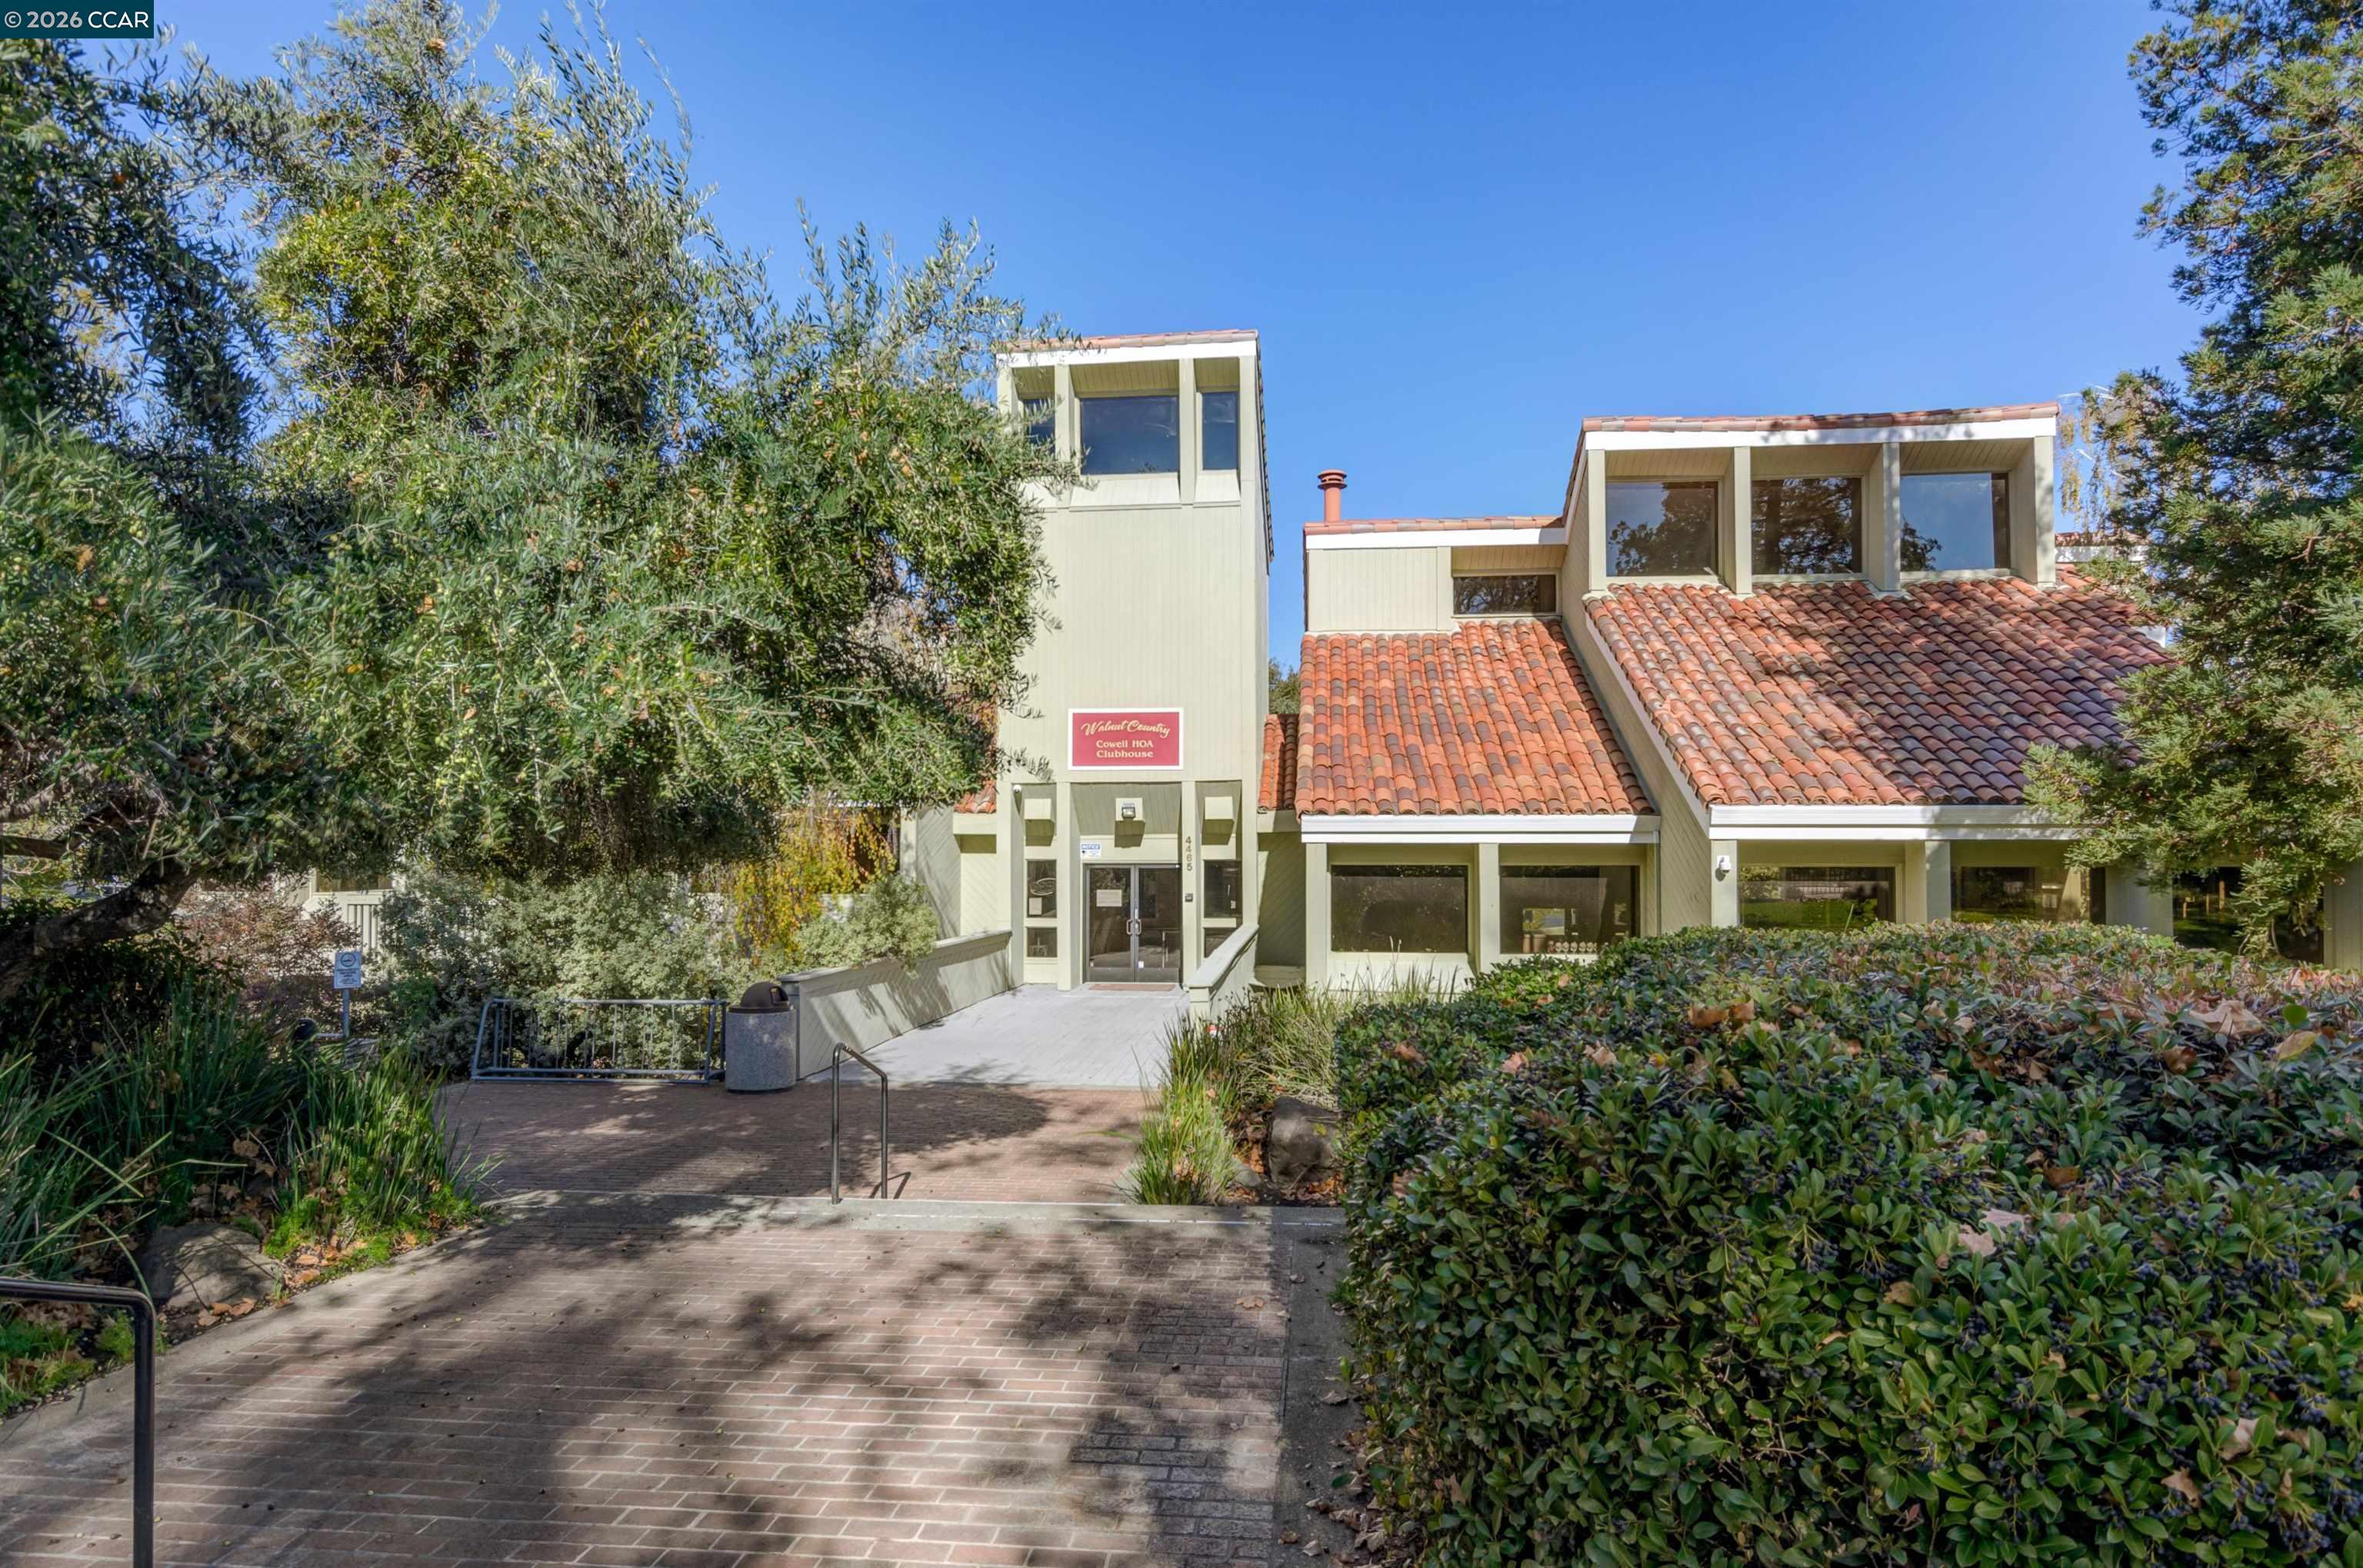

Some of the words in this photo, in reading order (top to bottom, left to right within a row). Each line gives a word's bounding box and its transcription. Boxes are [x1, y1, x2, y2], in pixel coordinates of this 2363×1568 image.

[1081, 721, 1127, 736] Walnut
[1127, 720, 1170, 738] Country
[1095, 740, 1128, 748] Cowell
[1132, 740, 1154, 748] HOA
[1095, 750, 1154, 758] Clubhouse
